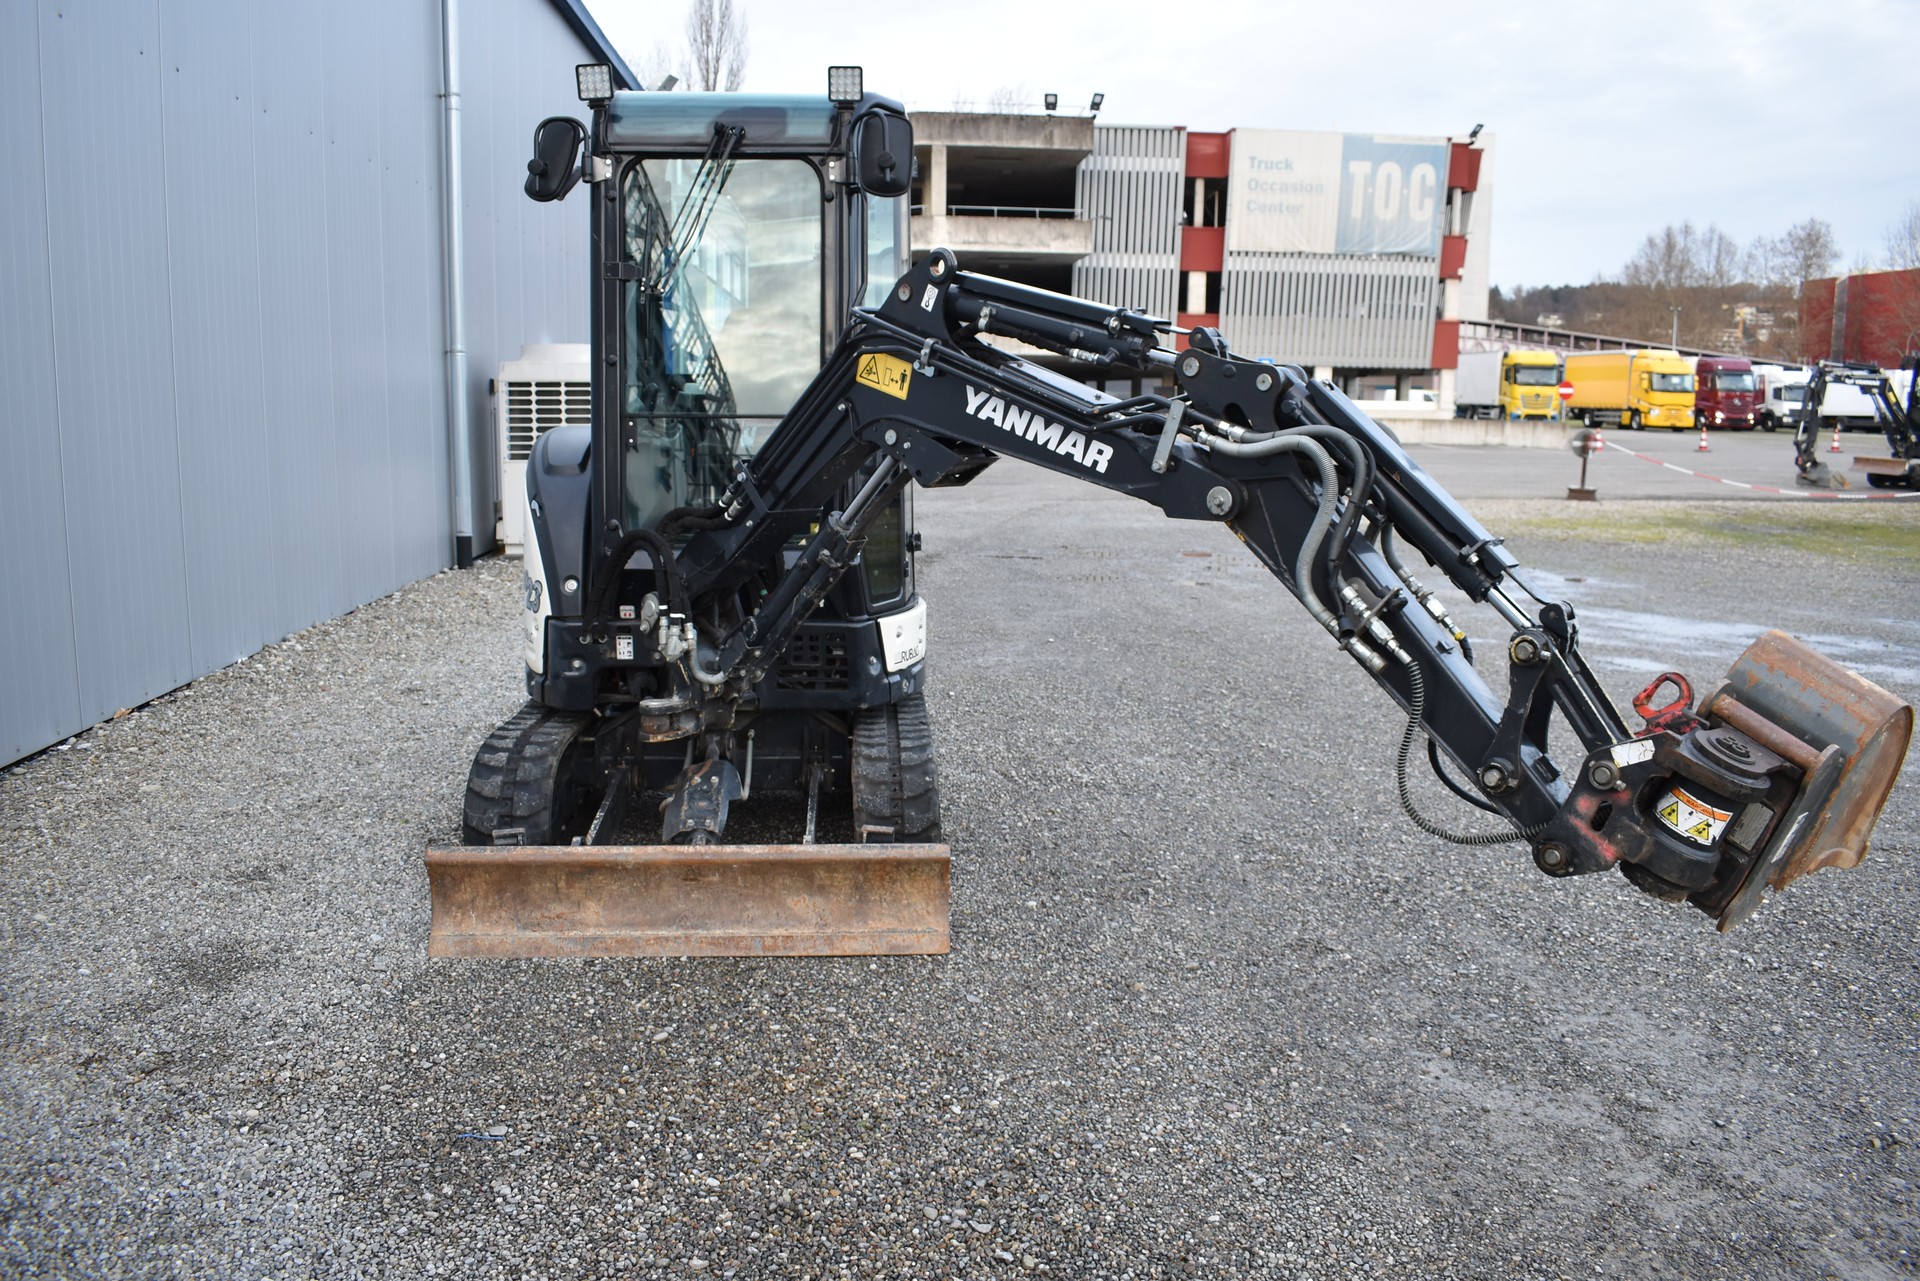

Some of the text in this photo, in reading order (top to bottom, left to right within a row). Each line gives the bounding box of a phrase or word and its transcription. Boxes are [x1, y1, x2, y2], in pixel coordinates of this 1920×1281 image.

[1248, 155, 1294, 172] Truck
[1247, 177, 1324, 194] Occasion
[1246, 199, 1304, 215] Center
[965, 385, 1114, 474] YANMAR
[1686, 798, 1714, 817] WARING
